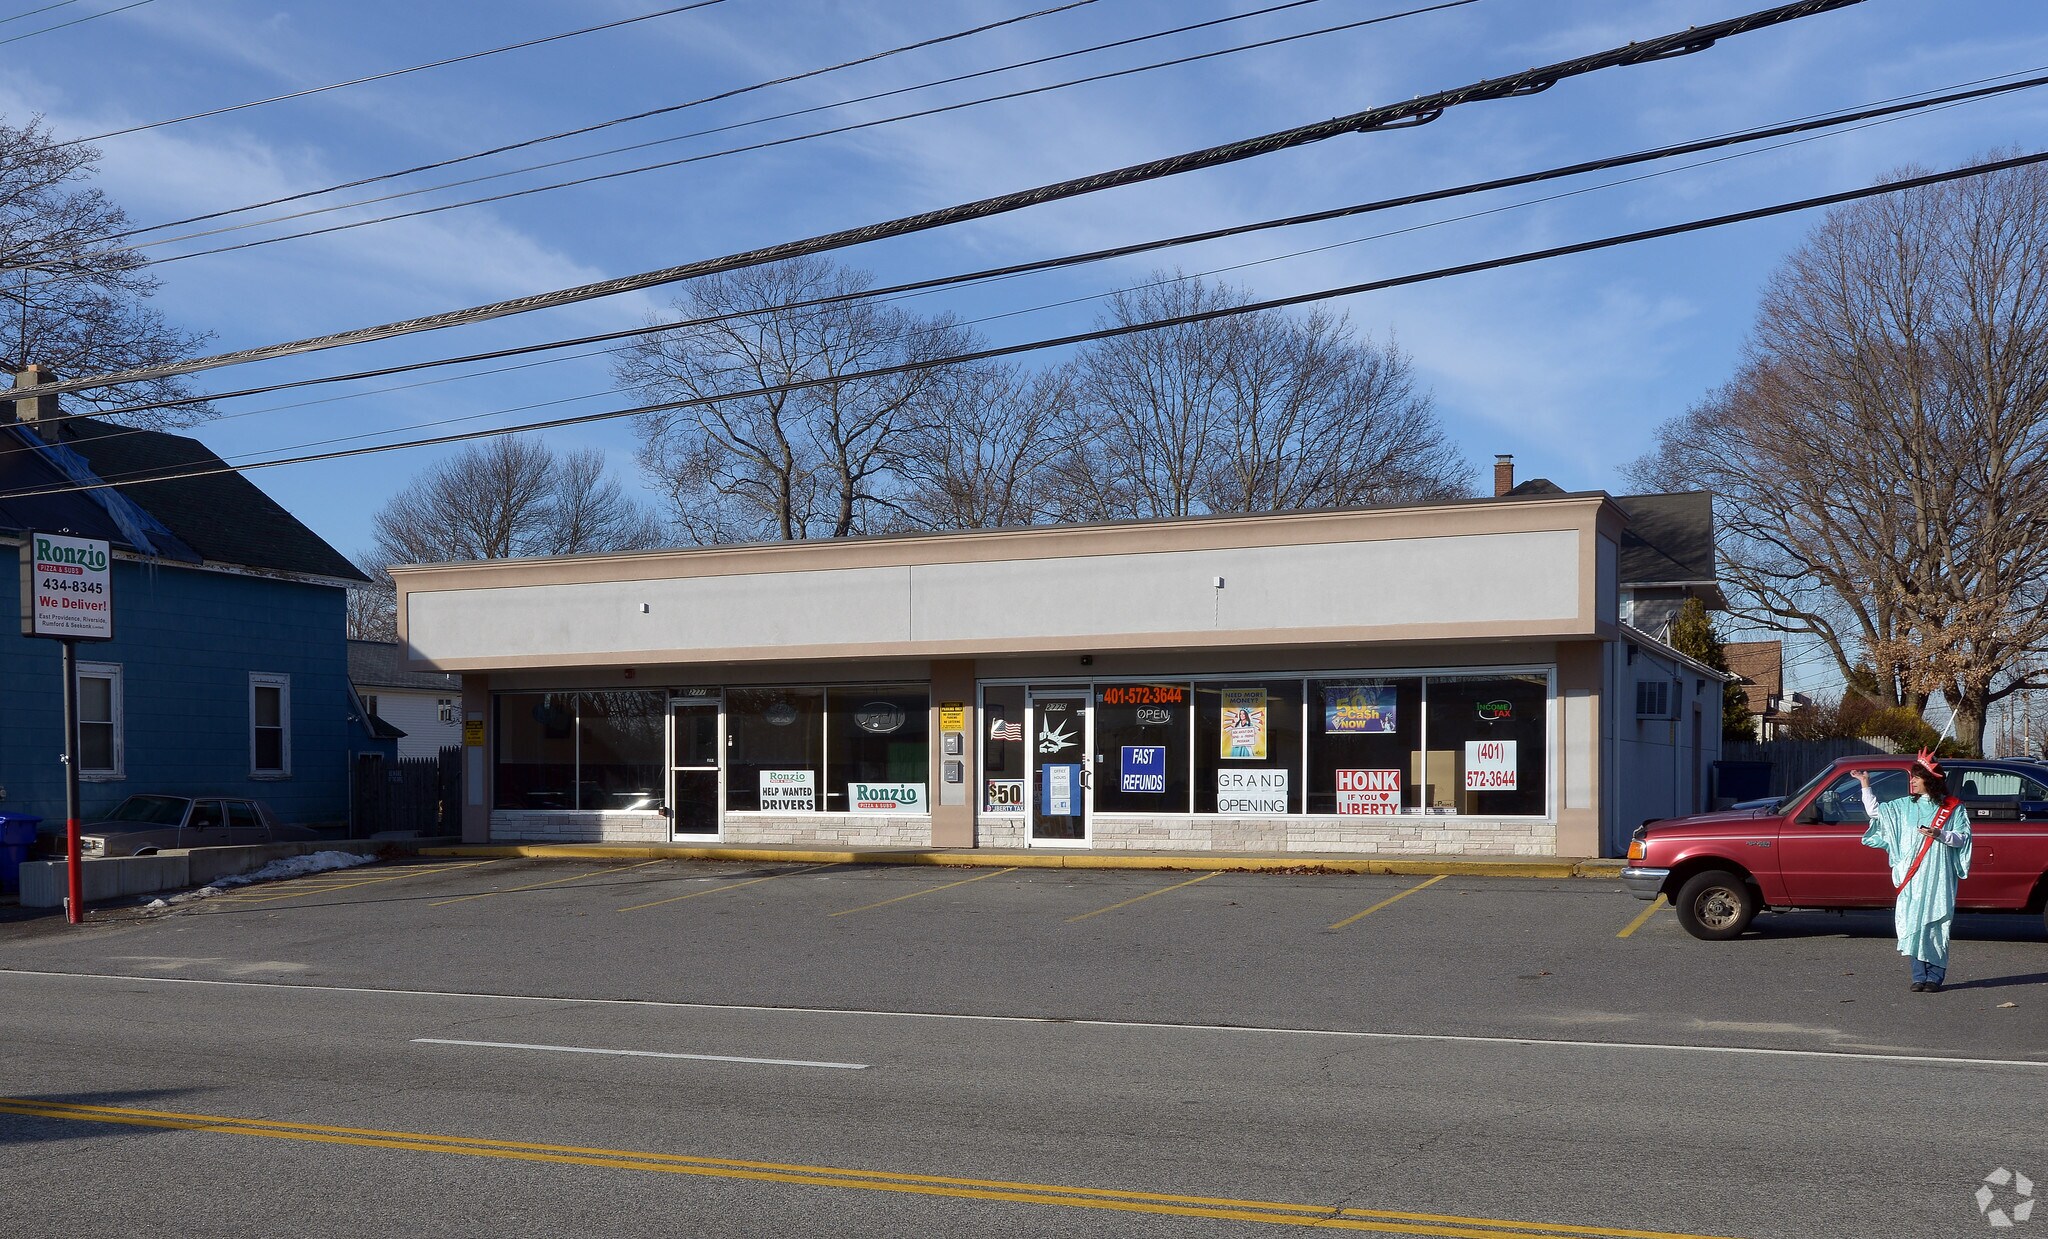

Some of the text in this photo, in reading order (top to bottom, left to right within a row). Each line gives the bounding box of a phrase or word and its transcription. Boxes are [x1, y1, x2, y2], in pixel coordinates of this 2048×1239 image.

[36, 538, 107, 572] Ronzio
[40, 564, 57, 572] PIZZA
[43, 578, 103, 594] 434-8345
[39, 596, 107, 611] We Deliver!
[1104, 688, 1182, 704] 401-572-3644
[1045, 703, 1068, 711] 2775
[1476, 702, 1508, 711] INCOME
[1137, 709, 1169, 719] OPEN
[1341, 720, 1366, 728] NOW
[1133, 749, 1154, 764] FAST
[1478, 743, 1504, 763] (401)
[770, 772, 805, 782] Ronzio
[1123, 774, 1162, 790] REFUNDS
[1219, 774, 1284, 786] GRAND
[1339, 772, 1398, 790] HONK
[1467, 771, 1515, 787] 572-3644
[763, 788, 812, 796] HELP WANTED
[856, 784, 917, 804] Ronzio
[989, 784, 1020, 804] $50
[762, 800, 813, 810] DRIVERS
[1219, 799, 1284, 812] OPENING
[1339, 802, 1398, 814] LIBERTY
